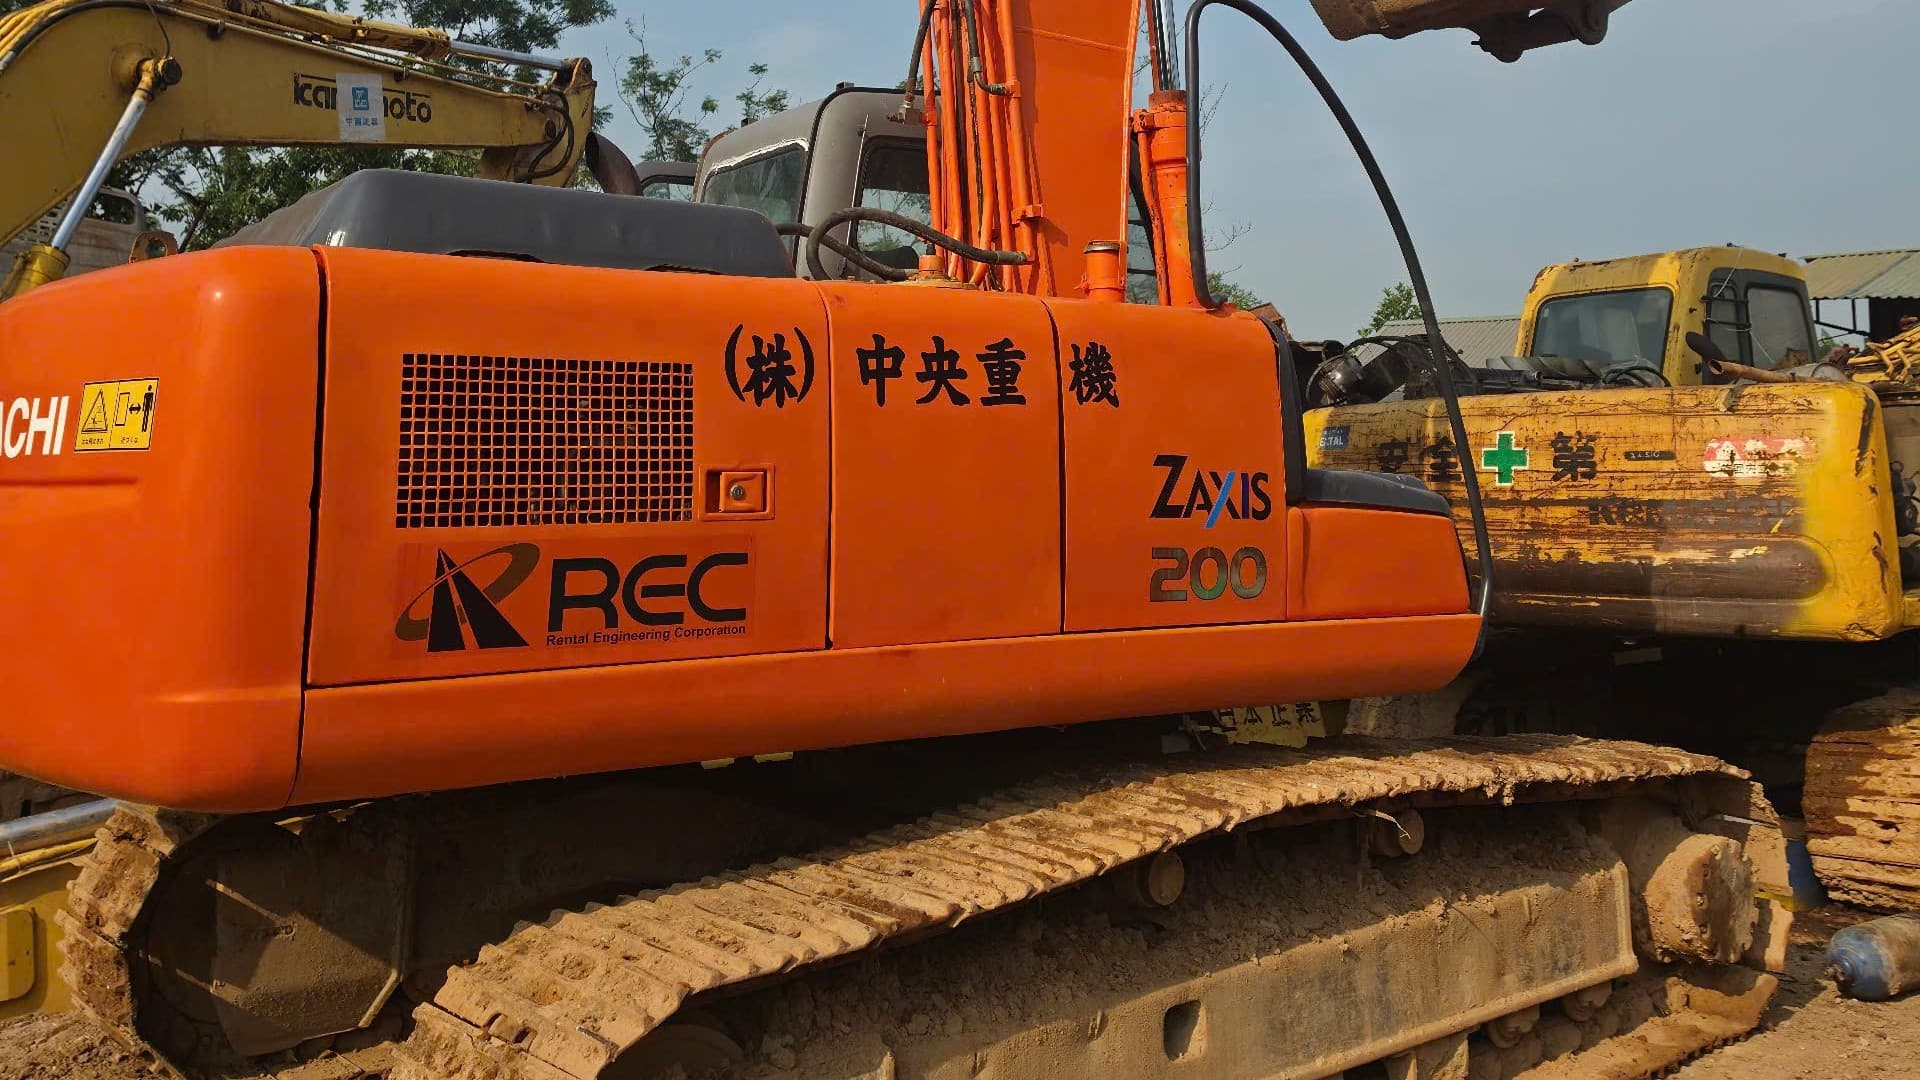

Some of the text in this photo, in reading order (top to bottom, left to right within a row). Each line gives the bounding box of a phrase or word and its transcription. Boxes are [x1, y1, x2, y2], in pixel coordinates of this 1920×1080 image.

[0, 396, 69, 458] CHI
[1150, 454, 1272, 528] ZAXIS
[547, 553, 748, 632] REC
[1150, 546, 1267, 602] 200
[546, 624, 746, 647] Rental Engineering Corporation
